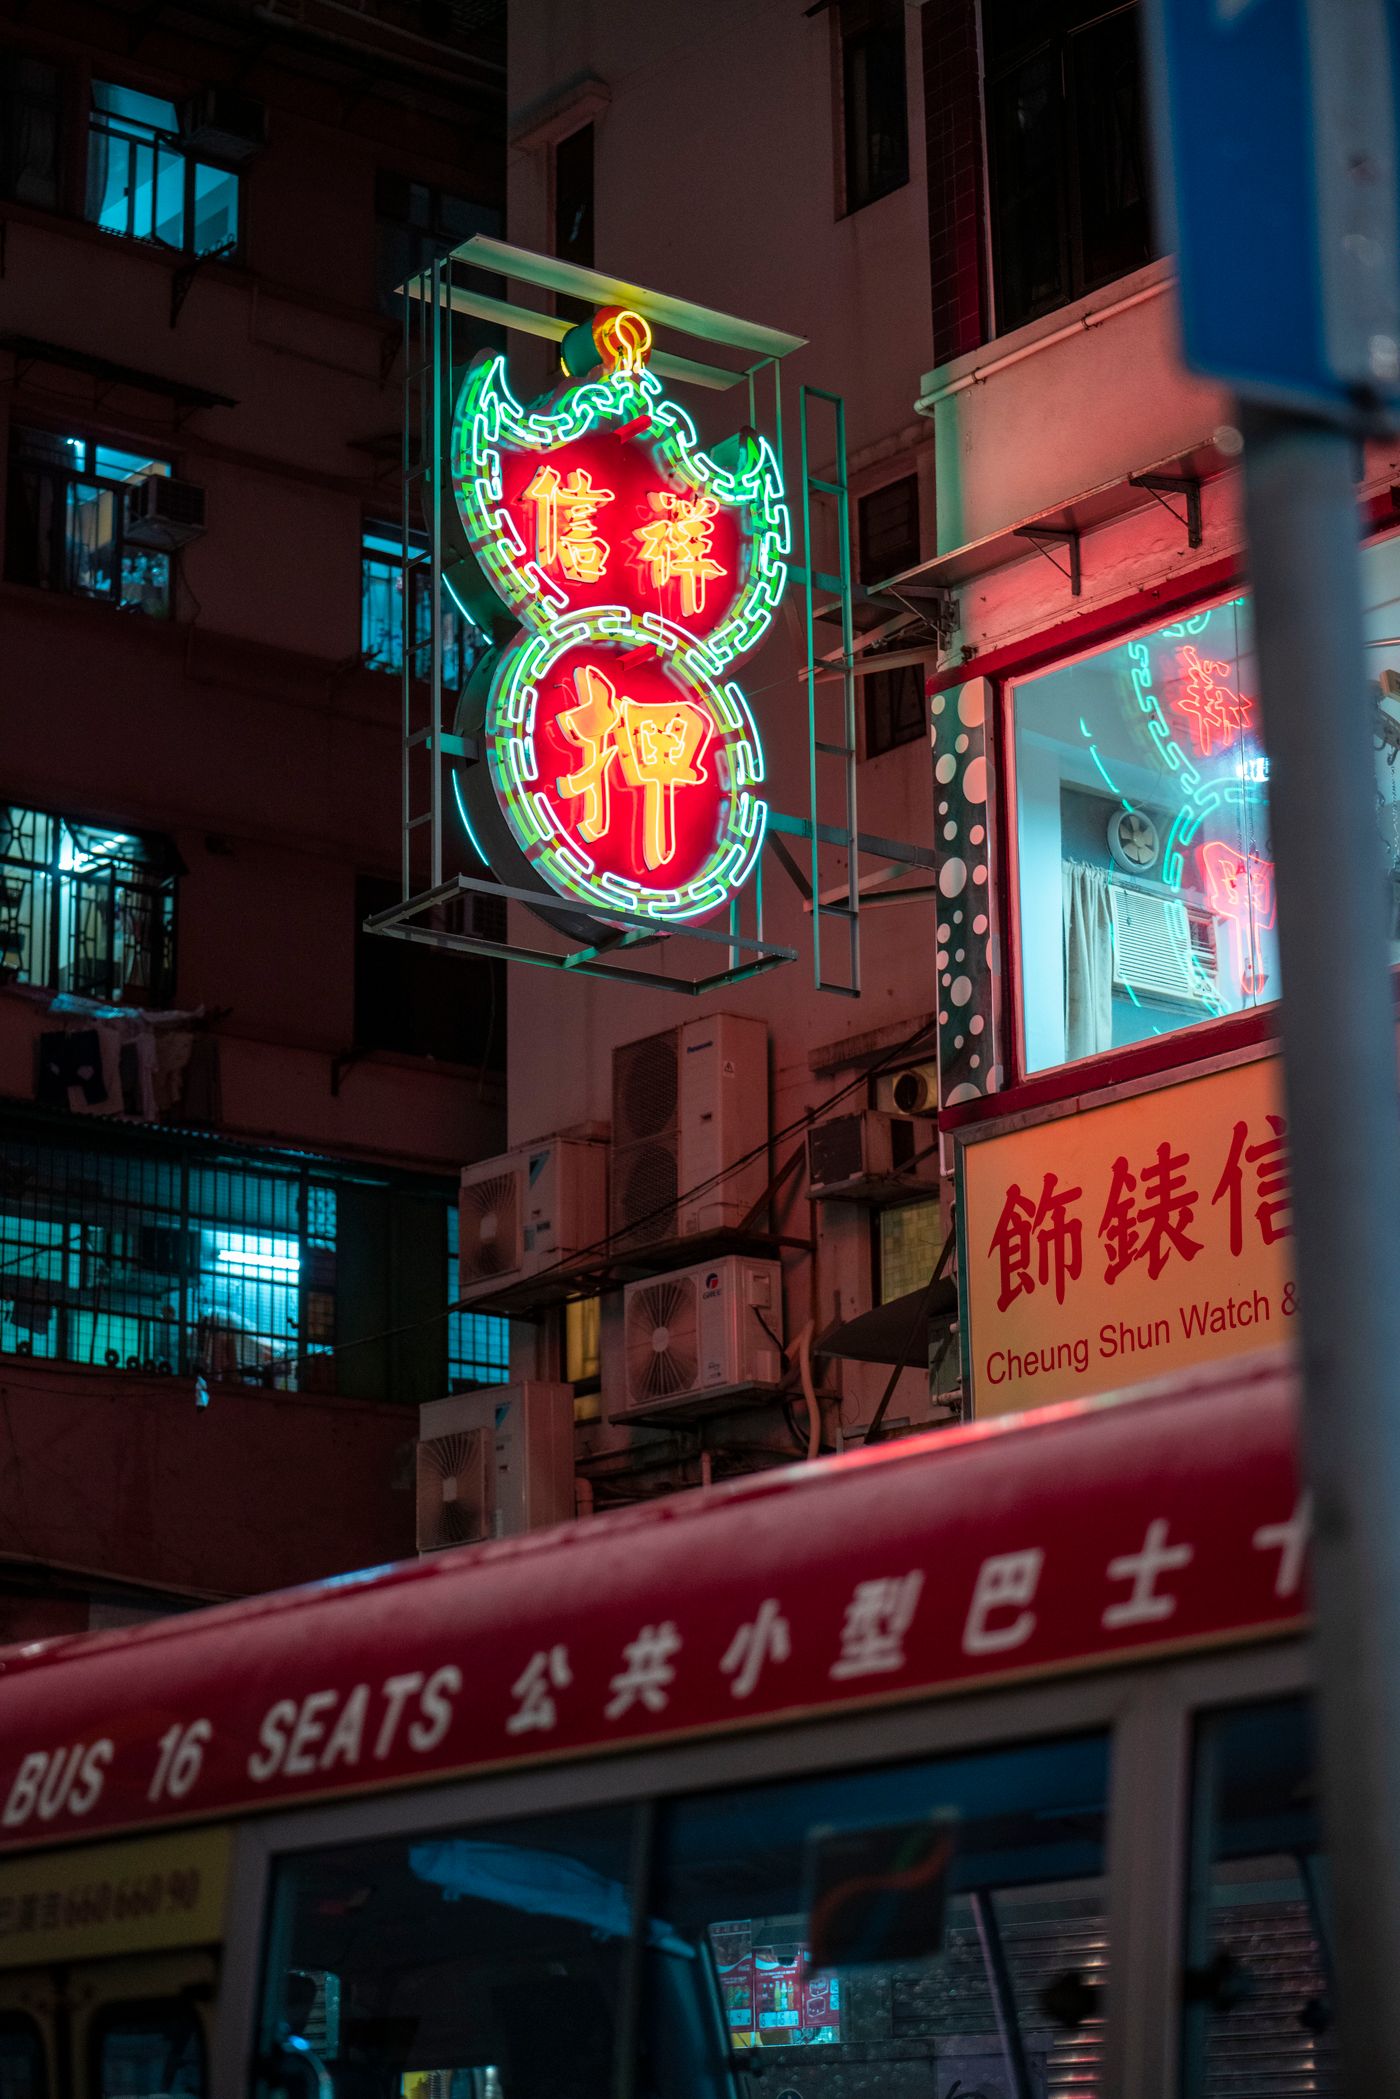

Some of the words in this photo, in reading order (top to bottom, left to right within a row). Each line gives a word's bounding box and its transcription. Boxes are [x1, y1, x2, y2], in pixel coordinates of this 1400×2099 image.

[554, 664, 716, 868] 押
[986, 1338, 1089, 1385] Cheung
[1099, 1318, 1171, 1359] Shun
[1179, 1289, 1270, 1340] Watch
[1280, 1281, 1301, 1317] &
[1, 1738, 114, 1827] BUS
[147, 1718, 213, 1802] 16
[247, 1664, 464, 1783] SEATS
